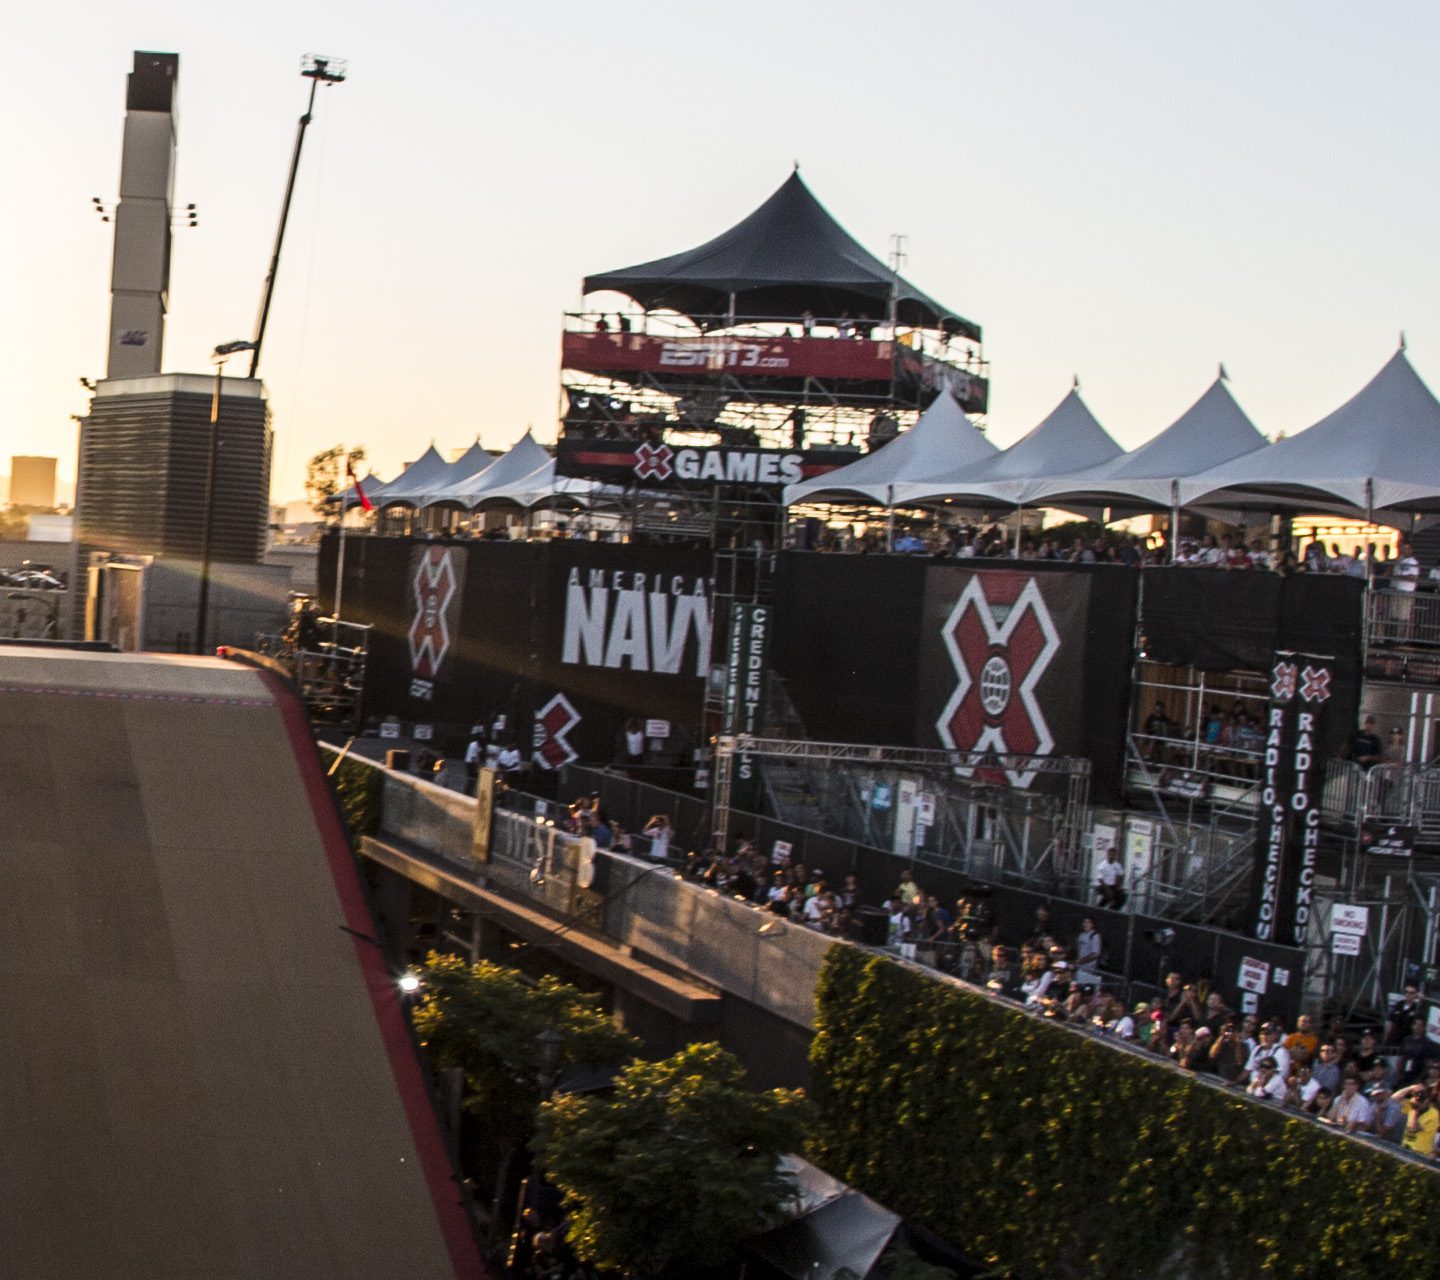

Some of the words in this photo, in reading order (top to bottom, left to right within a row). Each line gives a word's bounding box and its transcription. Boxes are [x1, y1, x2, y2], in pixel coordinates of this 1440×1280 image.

[674, 448, 805, 486] GAMES
[561, 585, 714, 678] NAVY
[738, 608, 768, 780] CREDENTILS
[1262, 708, 1283, 806] RADIO
[1291, 712, 1314, 811] RADIO
